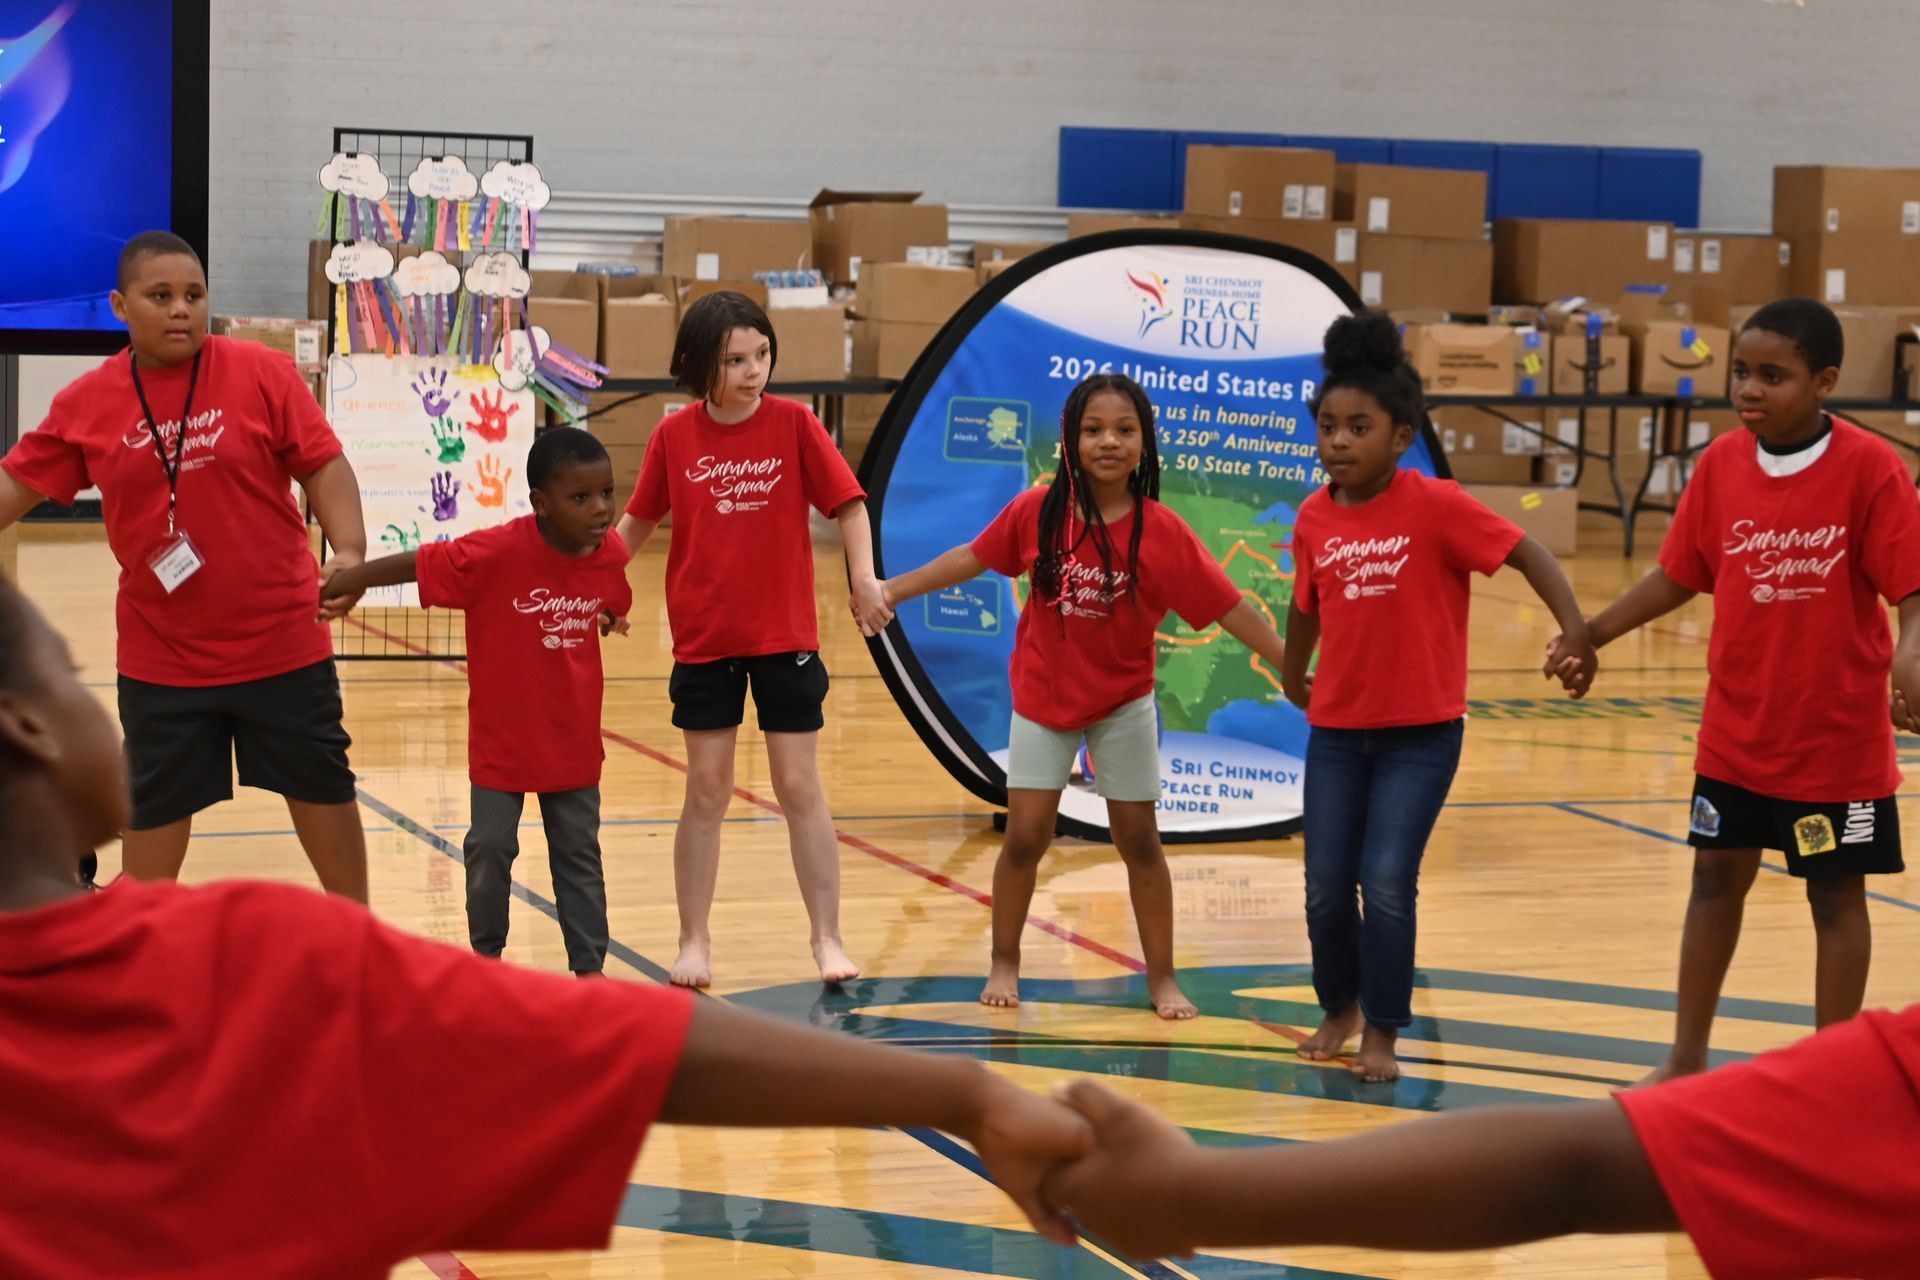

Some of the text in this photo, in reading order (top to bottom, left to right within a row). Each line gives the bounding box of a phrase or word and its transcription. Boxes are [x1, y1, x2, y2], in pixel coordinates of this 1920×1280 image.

[1183, 287, 1261, 298] ONENESS-HOME
[1184, 275, 1264, 289] SRI CHINMOY
[1183, 297, 1261, 321] PEACE
[1179, 319, 1259, 350] RUN
[1049, 355, 1113, 380] 2026
[1123, 363, 1209, 393] United
[1216, 372, 1294, 400] States
[1166, 406, 1187, 420] us
[1192, 404, 1211, 423] in
[1216, 406, 1297, 435] honoring
[1223, 434, 1322, 465] Anniversar
[685, 455, 783, 482] Summer
[1175, 454, 1199, 471] 50
[1204, 456, 1252, 476] State
[1258, 461, 1305, 482] Torch
[710, 474, 782, 500] Squad
[1722, 519, 1846, 555] Summer
[1315, 535, 1410, 568] Summer
[1336, 554, 1409, 583] Squad
[1745, 549, 1846, 583] Squad
[512, 588, 603, 614] Summer
[940, 606, 969, 617] Hawaii
[1171, 758, 1299, 785] SRI CHINMOY
[1160, 780, 1254, 799] PEACE RUN
[1155, 799, 1220, 814] OUNDER
